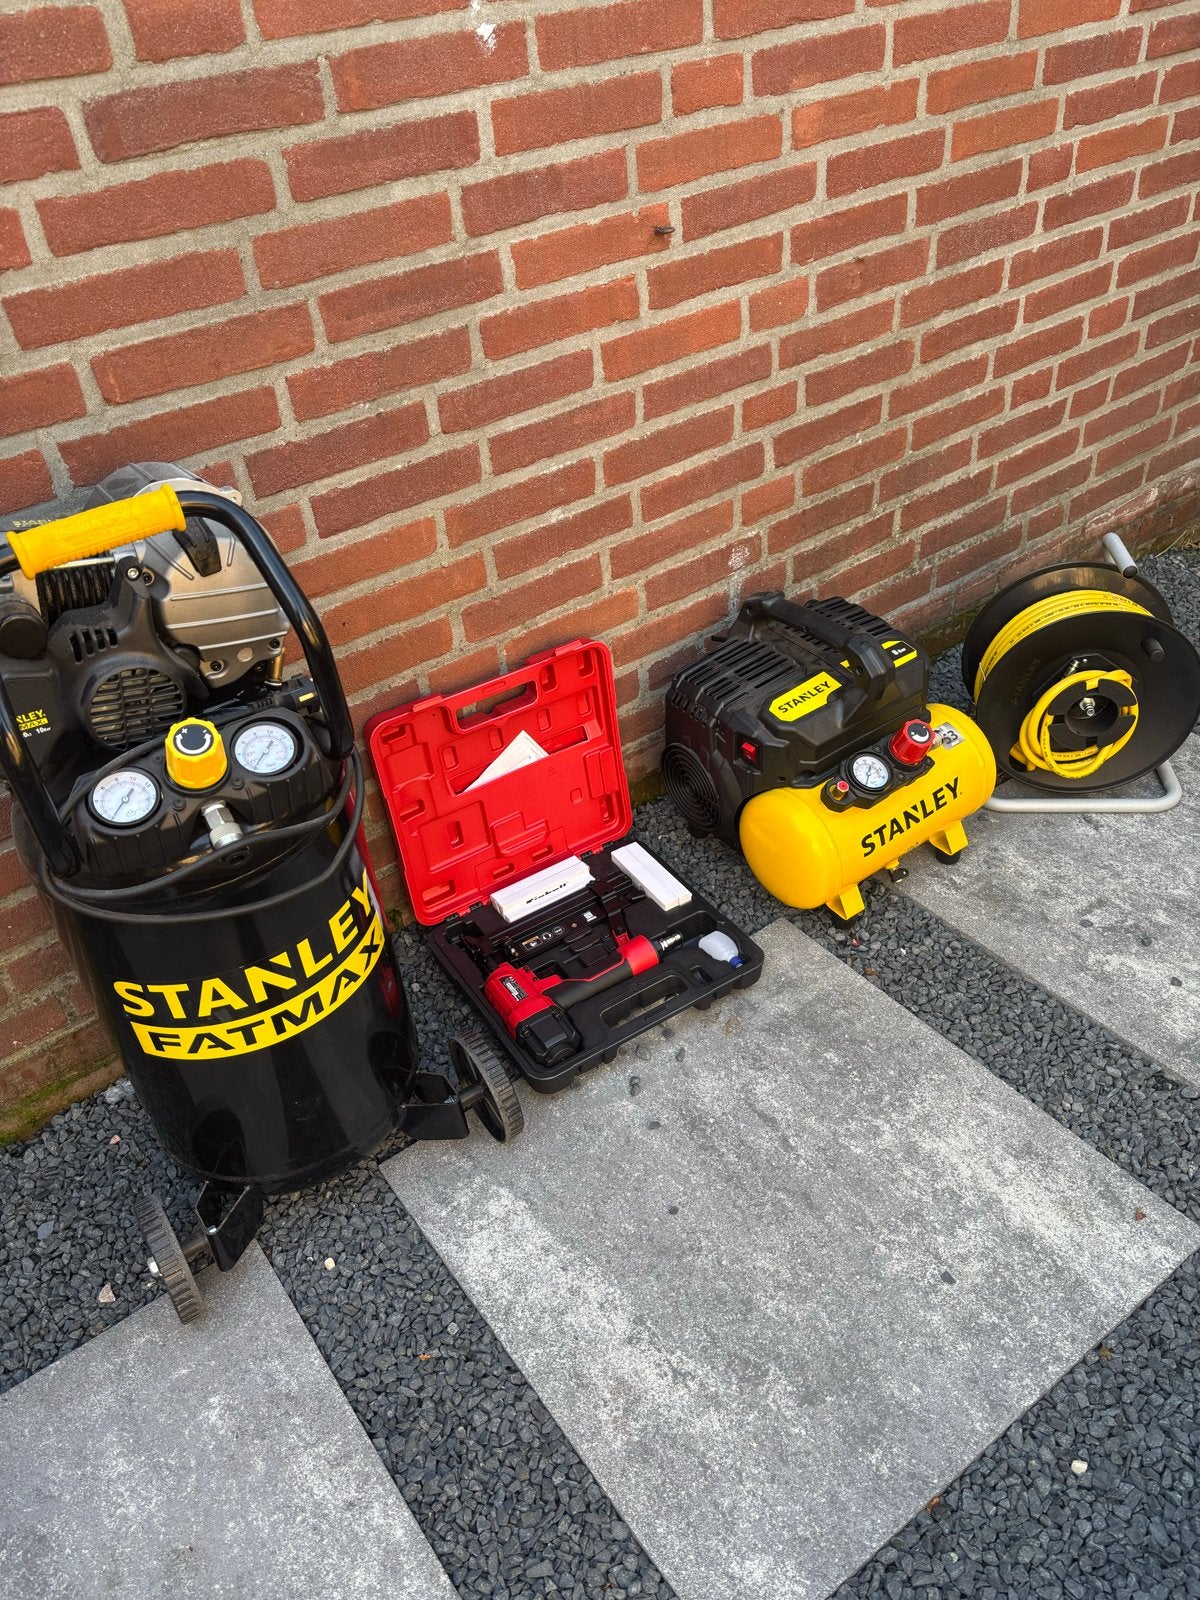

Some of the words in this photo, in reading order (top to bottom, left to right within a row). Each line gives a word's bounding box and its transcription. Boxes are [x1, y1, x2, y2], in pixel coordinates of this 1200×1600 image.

[778, 680, 831, 714] STANLEY
[861, 776, 959, 858] STANLEY
[113, 866, 372, 1020] STANLEY
[148, 921, 382, 1054] FATMAX
